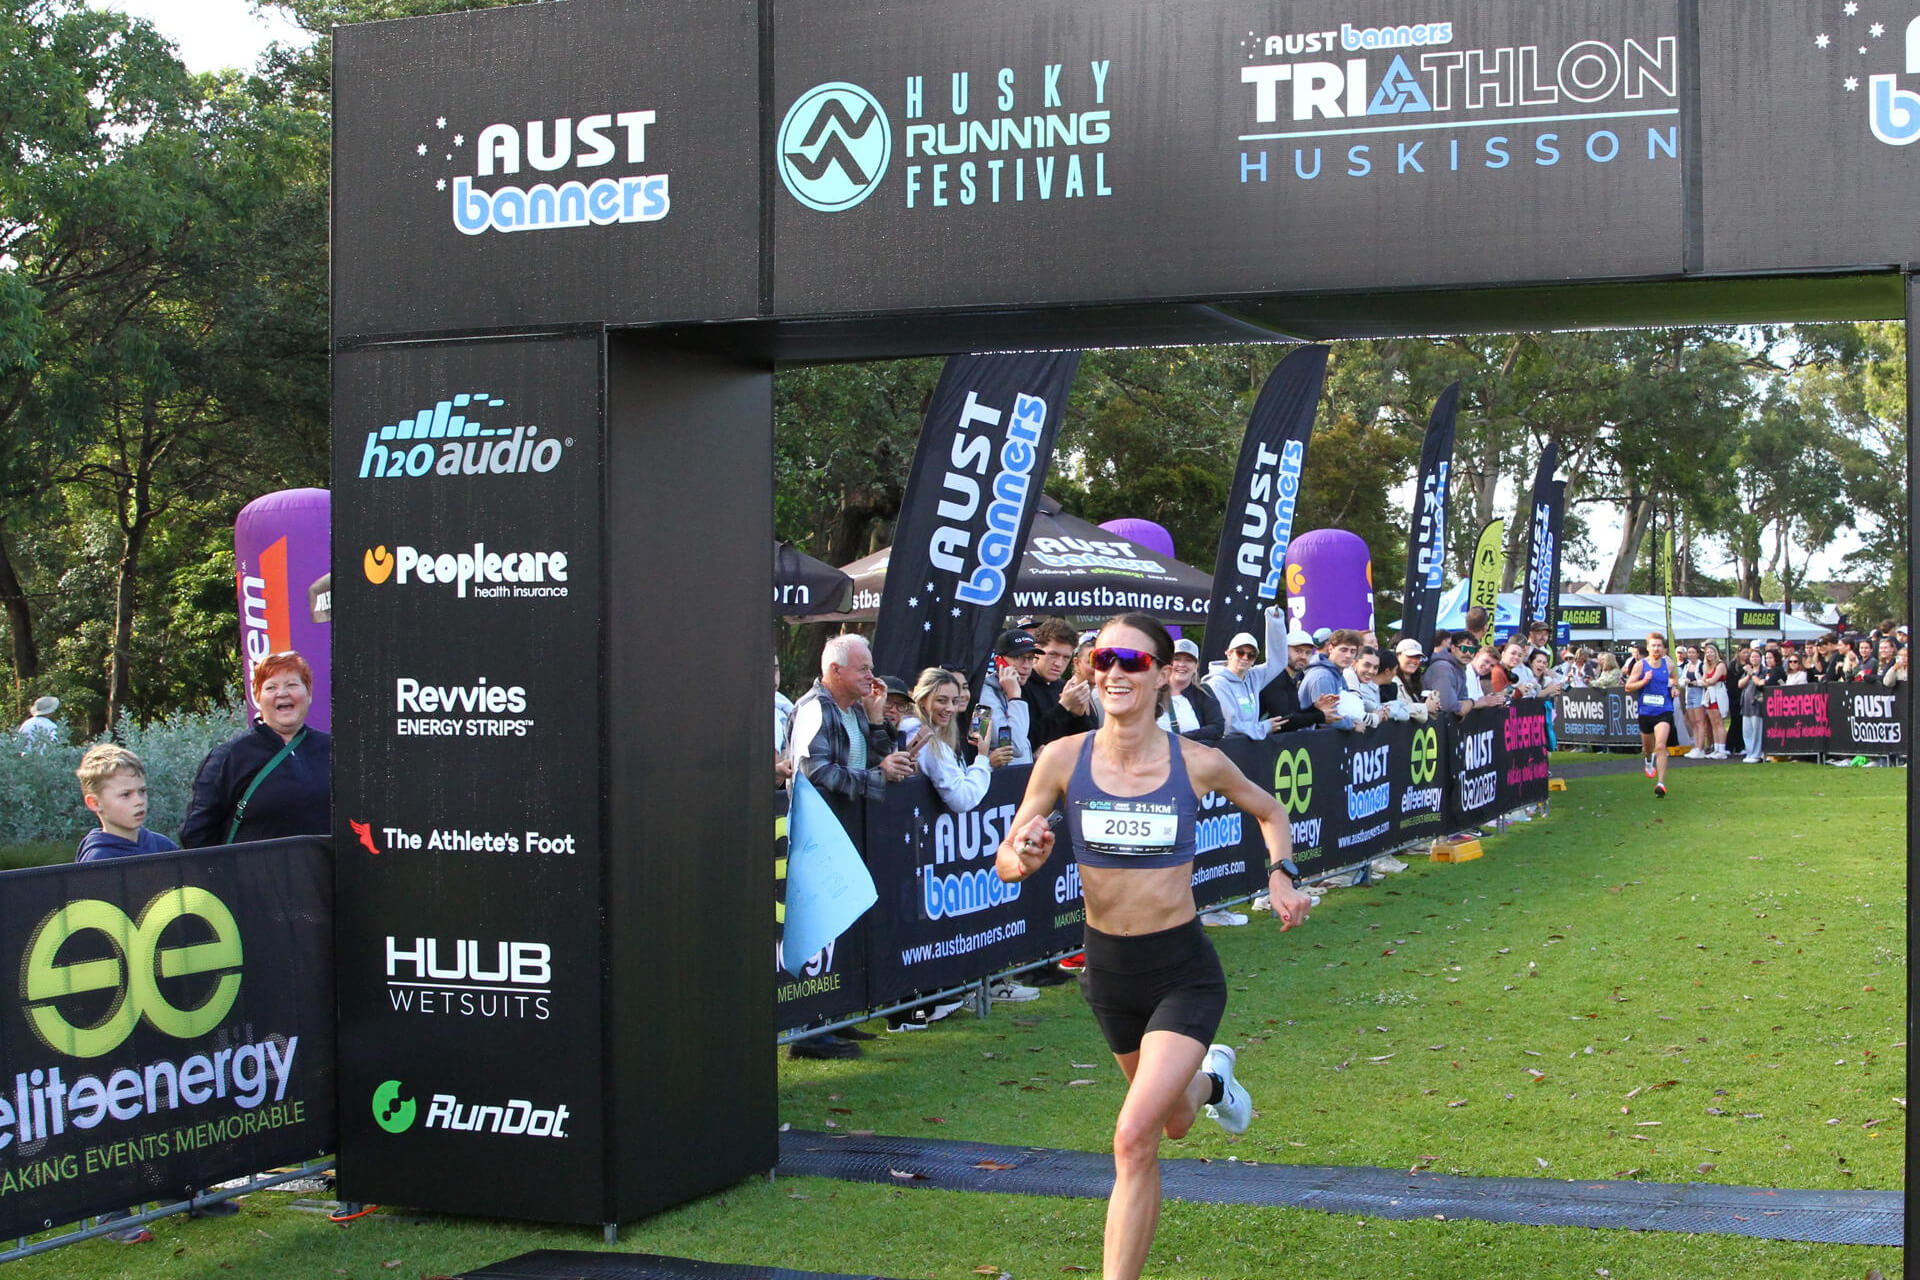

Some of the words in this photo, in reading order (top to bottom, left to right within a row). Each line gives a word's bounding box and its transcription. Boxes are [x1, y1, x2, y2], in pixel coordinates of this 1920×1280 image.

[1264, 31, 1338, 56] AUST
[1340, 22, 1453, 51] banners
[906, 60, 1111, 119] HUSKY
[477, 109, 657, 177] AUST
[1239, 126, 1678, 183] HUSKISSON
[906, 152, 1113, 209] FESTIVAL
[452, 173, 671, 236] banners
[929, 391, 1002, 574] AUST
[955, 392, 1048, 606] banners
[1237, 442, 1279, 578] AUST
[1257, 439, 1304, 600] banners
[1030, 551, 1167, 574] banners
[1033, 536, 1137, 558] AUST
[396, 542, 568, 598] Peoplecare
[474, 586, 510, 598] health
[513, 586, 569, 598] insurance
[1562, 610, 1601, 624] BAGGAGE
[1742, 612, 1776, 625] BAGGAGE
[396, 676, 527, 713] Revvies
[1562, 694, 1604, 720] Revvies
[1854, 694, 1895, 718] AUST
[396, 719, 463, 736] ENERGY
[1850, 716, 1901, 743] banners
[1353, 744, 1389, 785] AUST
[1465, 729, 1494, 771] AUST
[1136, 803, 1171, 814] 21.1KM
[1347, 782, 1390, 820] banners
[1458, 770, 1497, 812] banners
[383, 828, 422, 850] The
[427, 829, 519, 853] Athlete's
[525, 831, 576, 854] Foot
[935, 804, 1015, 864] AUST
[1105, 819, 1152, 837] 2035
[386, 935, 551, 984] HUUB
[902, 919, 1026, 966] www.austbanners.com
[388, 989, 550, 1020] WETSUITS
[777, 973, 841, 1004] MEMORABLE
[0, 1154, 79, 1197] AKING
[86, 1133, 170, 1174] EVENTS
[176, 1100, 305, 1153] MEMORABLE
